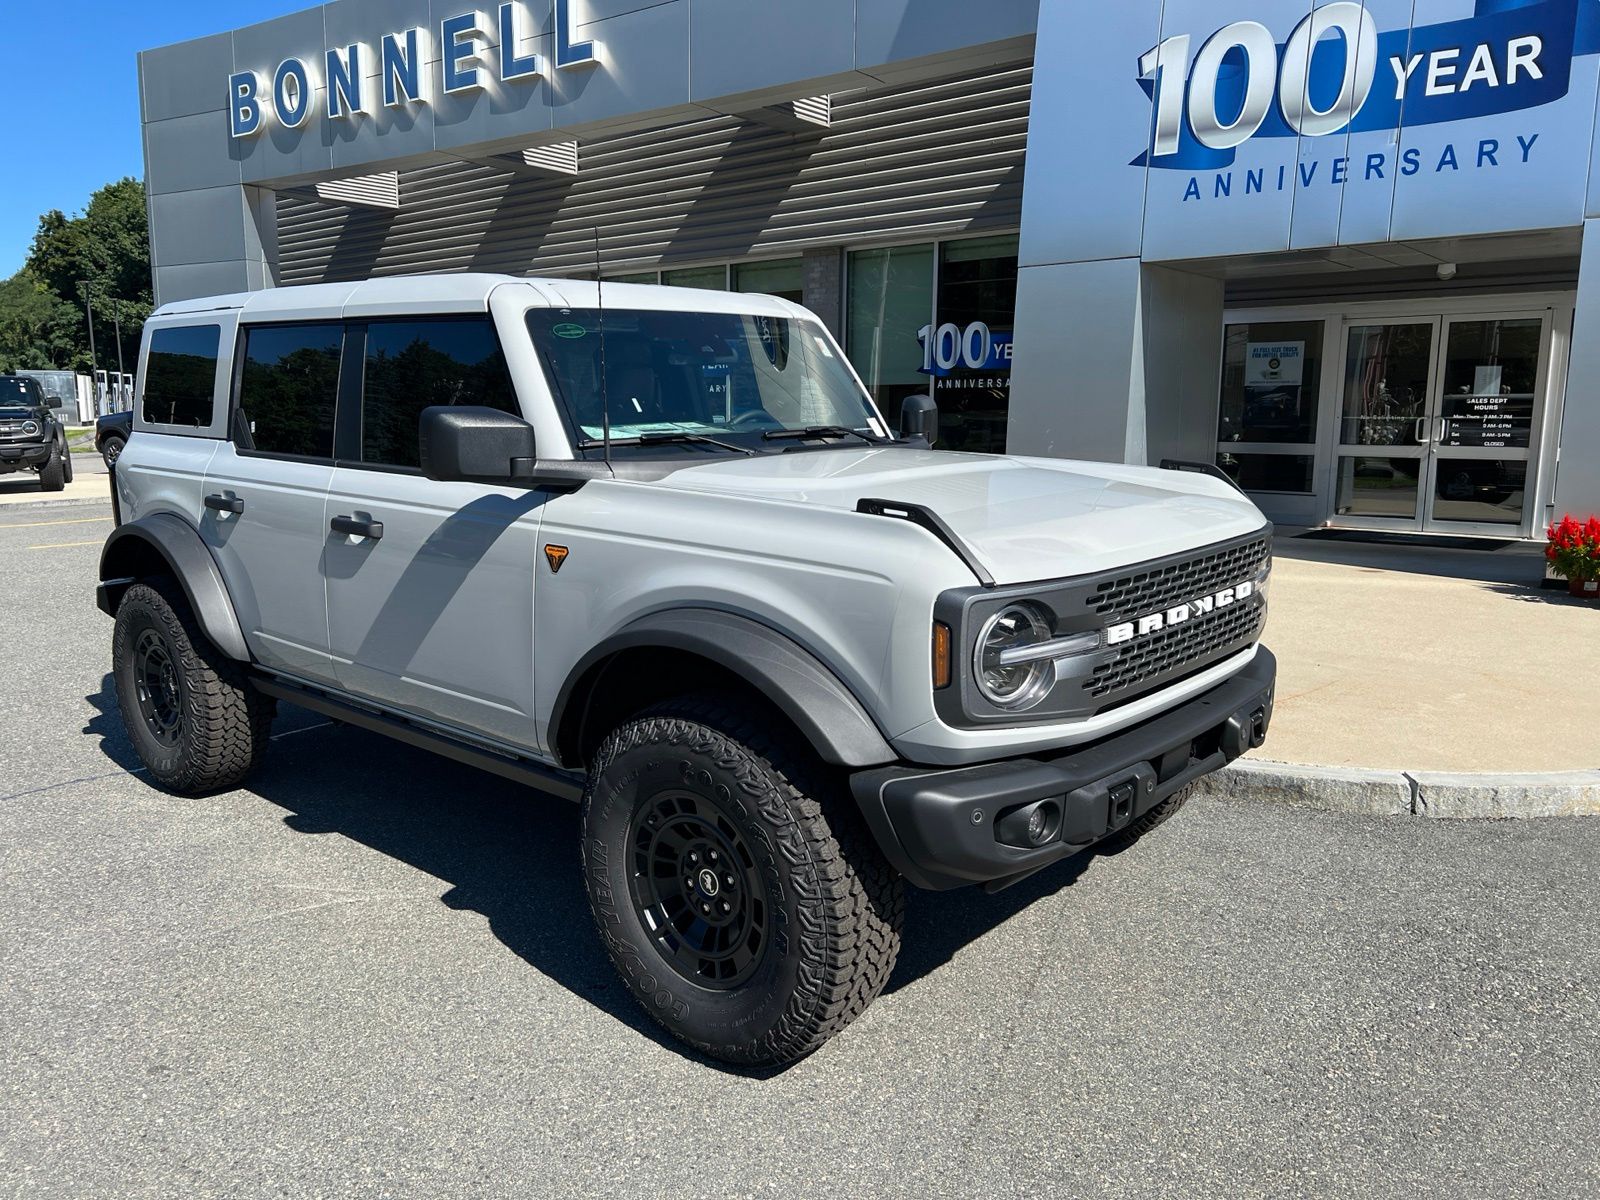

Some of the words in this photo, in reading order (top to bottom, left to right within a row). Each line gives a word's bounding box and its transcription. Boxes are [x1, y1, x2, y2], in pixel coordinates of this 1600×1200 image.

[227, 0, 602, 138] BONNELL
[1137, 1, 1378, 157] 100
[1389, 35, 1543, 100] YEAR
[1183, 134, 1539, 201] ANNIVERSARY
[917, 321, 991, 370] 100
[1107, 581, 1251, 644] BRONCO
